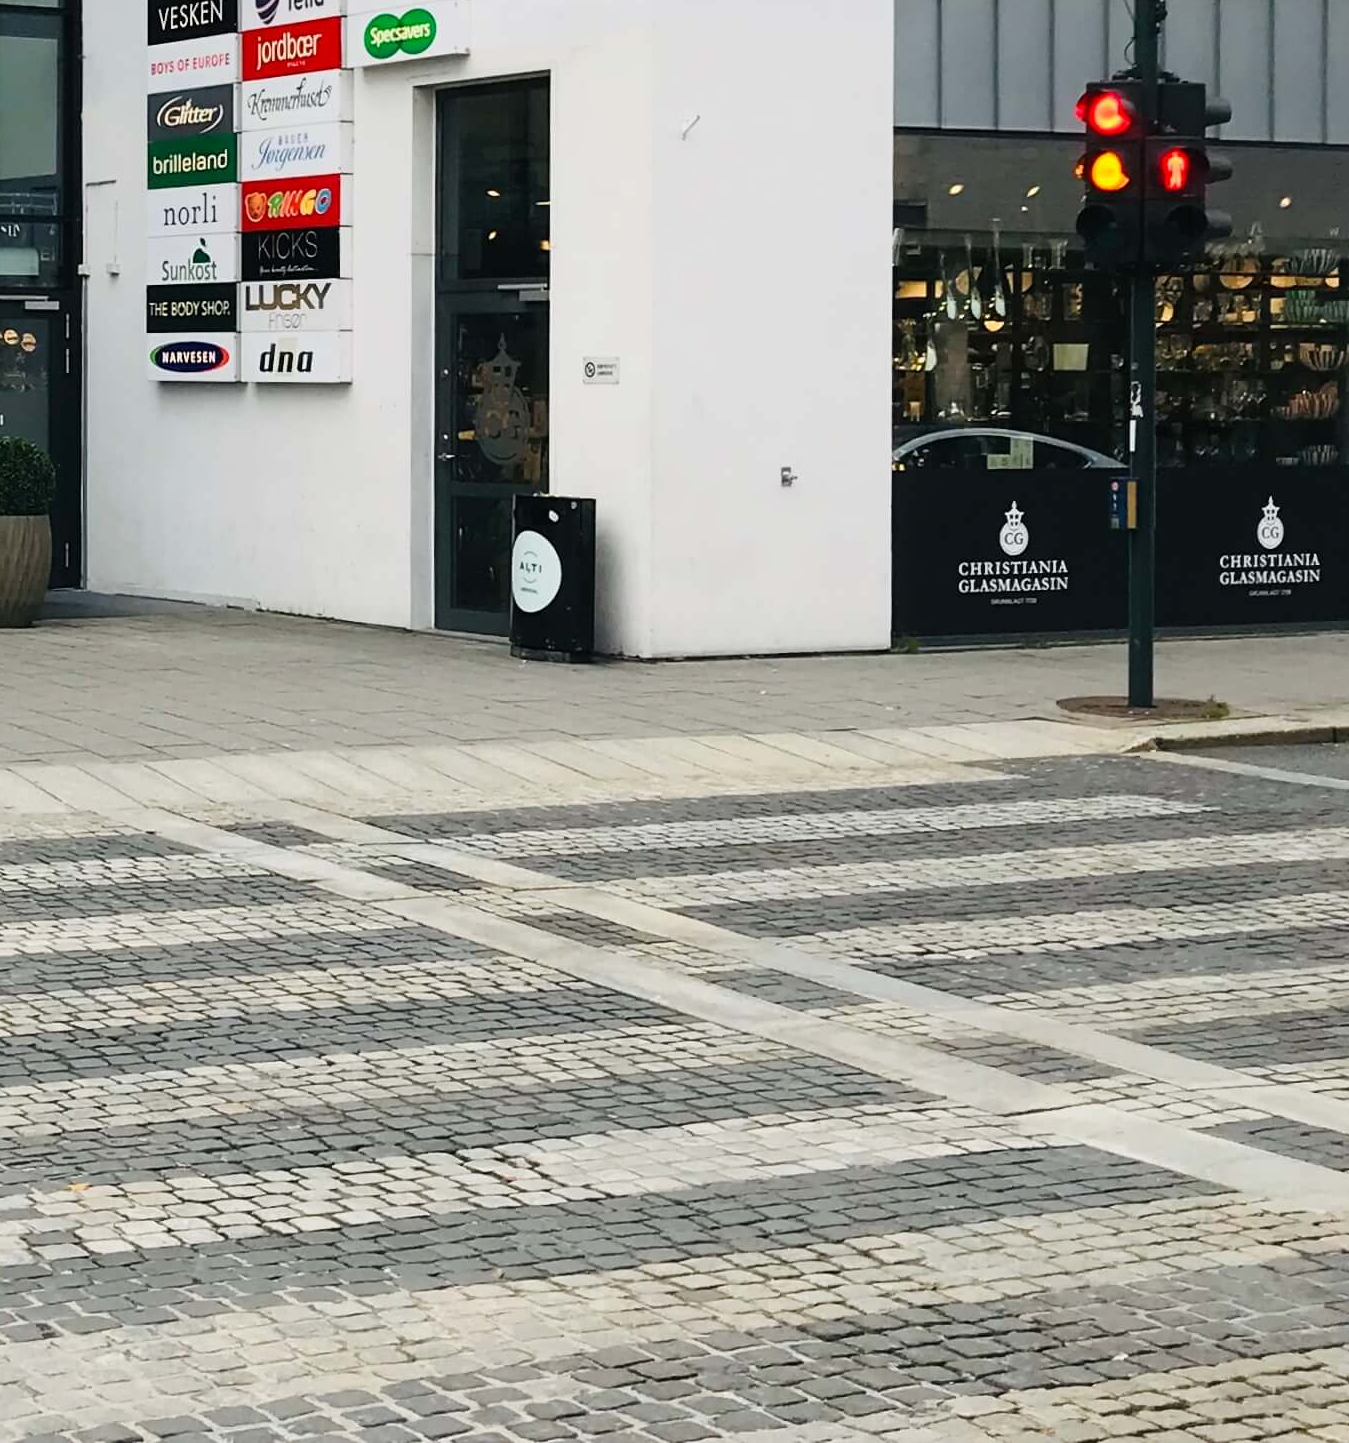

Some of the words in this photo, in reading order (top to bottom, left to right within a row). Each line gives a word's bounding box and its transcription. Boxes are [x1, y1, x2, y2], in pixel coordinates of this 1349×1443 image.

[370, 20, 430, 48] Specsavers
[151, 61, 175, 76] BOYS
[178, 59, 190, 72] OF
[193, 52, 230, 69] EUROPE
[163, 99, 217, 126] Glitter
[153, 149, 228, 174] brilleland
[163, 193, 217, 226] norli
[259, 231, 318, 259] KICKS
[162, 260, 217, 281] Sunkost
[245, 283, 332, 311] LUCKY
[149, 303, 169, 316] THE
[171, 301, 199, 316] BODY
[162, 350, 216, 364] NARVESEN
[260, 344, 313, 373] dna
[1004, 532, 1024, 546] CG
[1261, 526, 1280, 539] CG
[520, 562, 542, 573] ALTI
[958, 561, 1068, 576] CHRISTIANIA
[1220, 553, 1320, 568] CHRISTIANIA
[958, 576, 1069, 593] GLASMAGASIN
[1220, 569, 1320, 586] GLASMAGASIN
